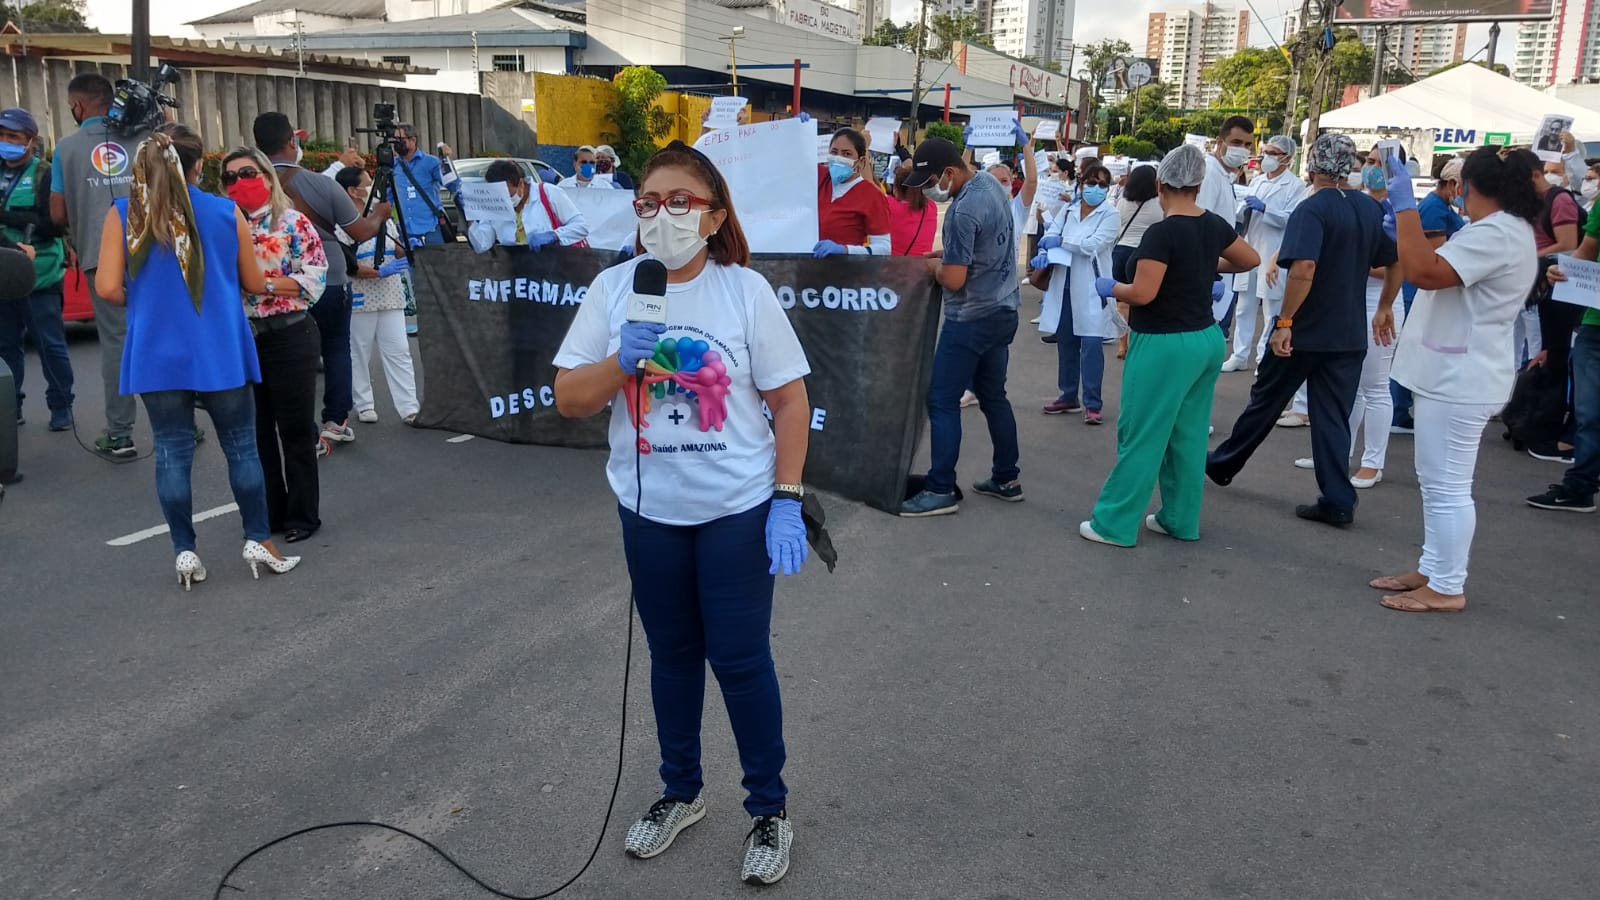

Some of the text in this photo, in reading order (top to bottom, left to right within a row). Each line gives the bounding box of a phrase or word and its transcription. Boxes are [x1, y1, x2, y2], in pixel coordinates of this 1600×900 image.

[790, 10, 854, 39] FABRICA MAGISTRAL
[87, 177, 99, 187] TV
[468, 278, 589, 306] ENFERMAG
[684, 325, 704, 335] UNIDA
[704, 332, 714, 341] DO
[714, 339, 739, 368] AMAZONAS
[652, 444, 678, 453] Saúde
[680, 442, 728, 453] AMAZONAS
